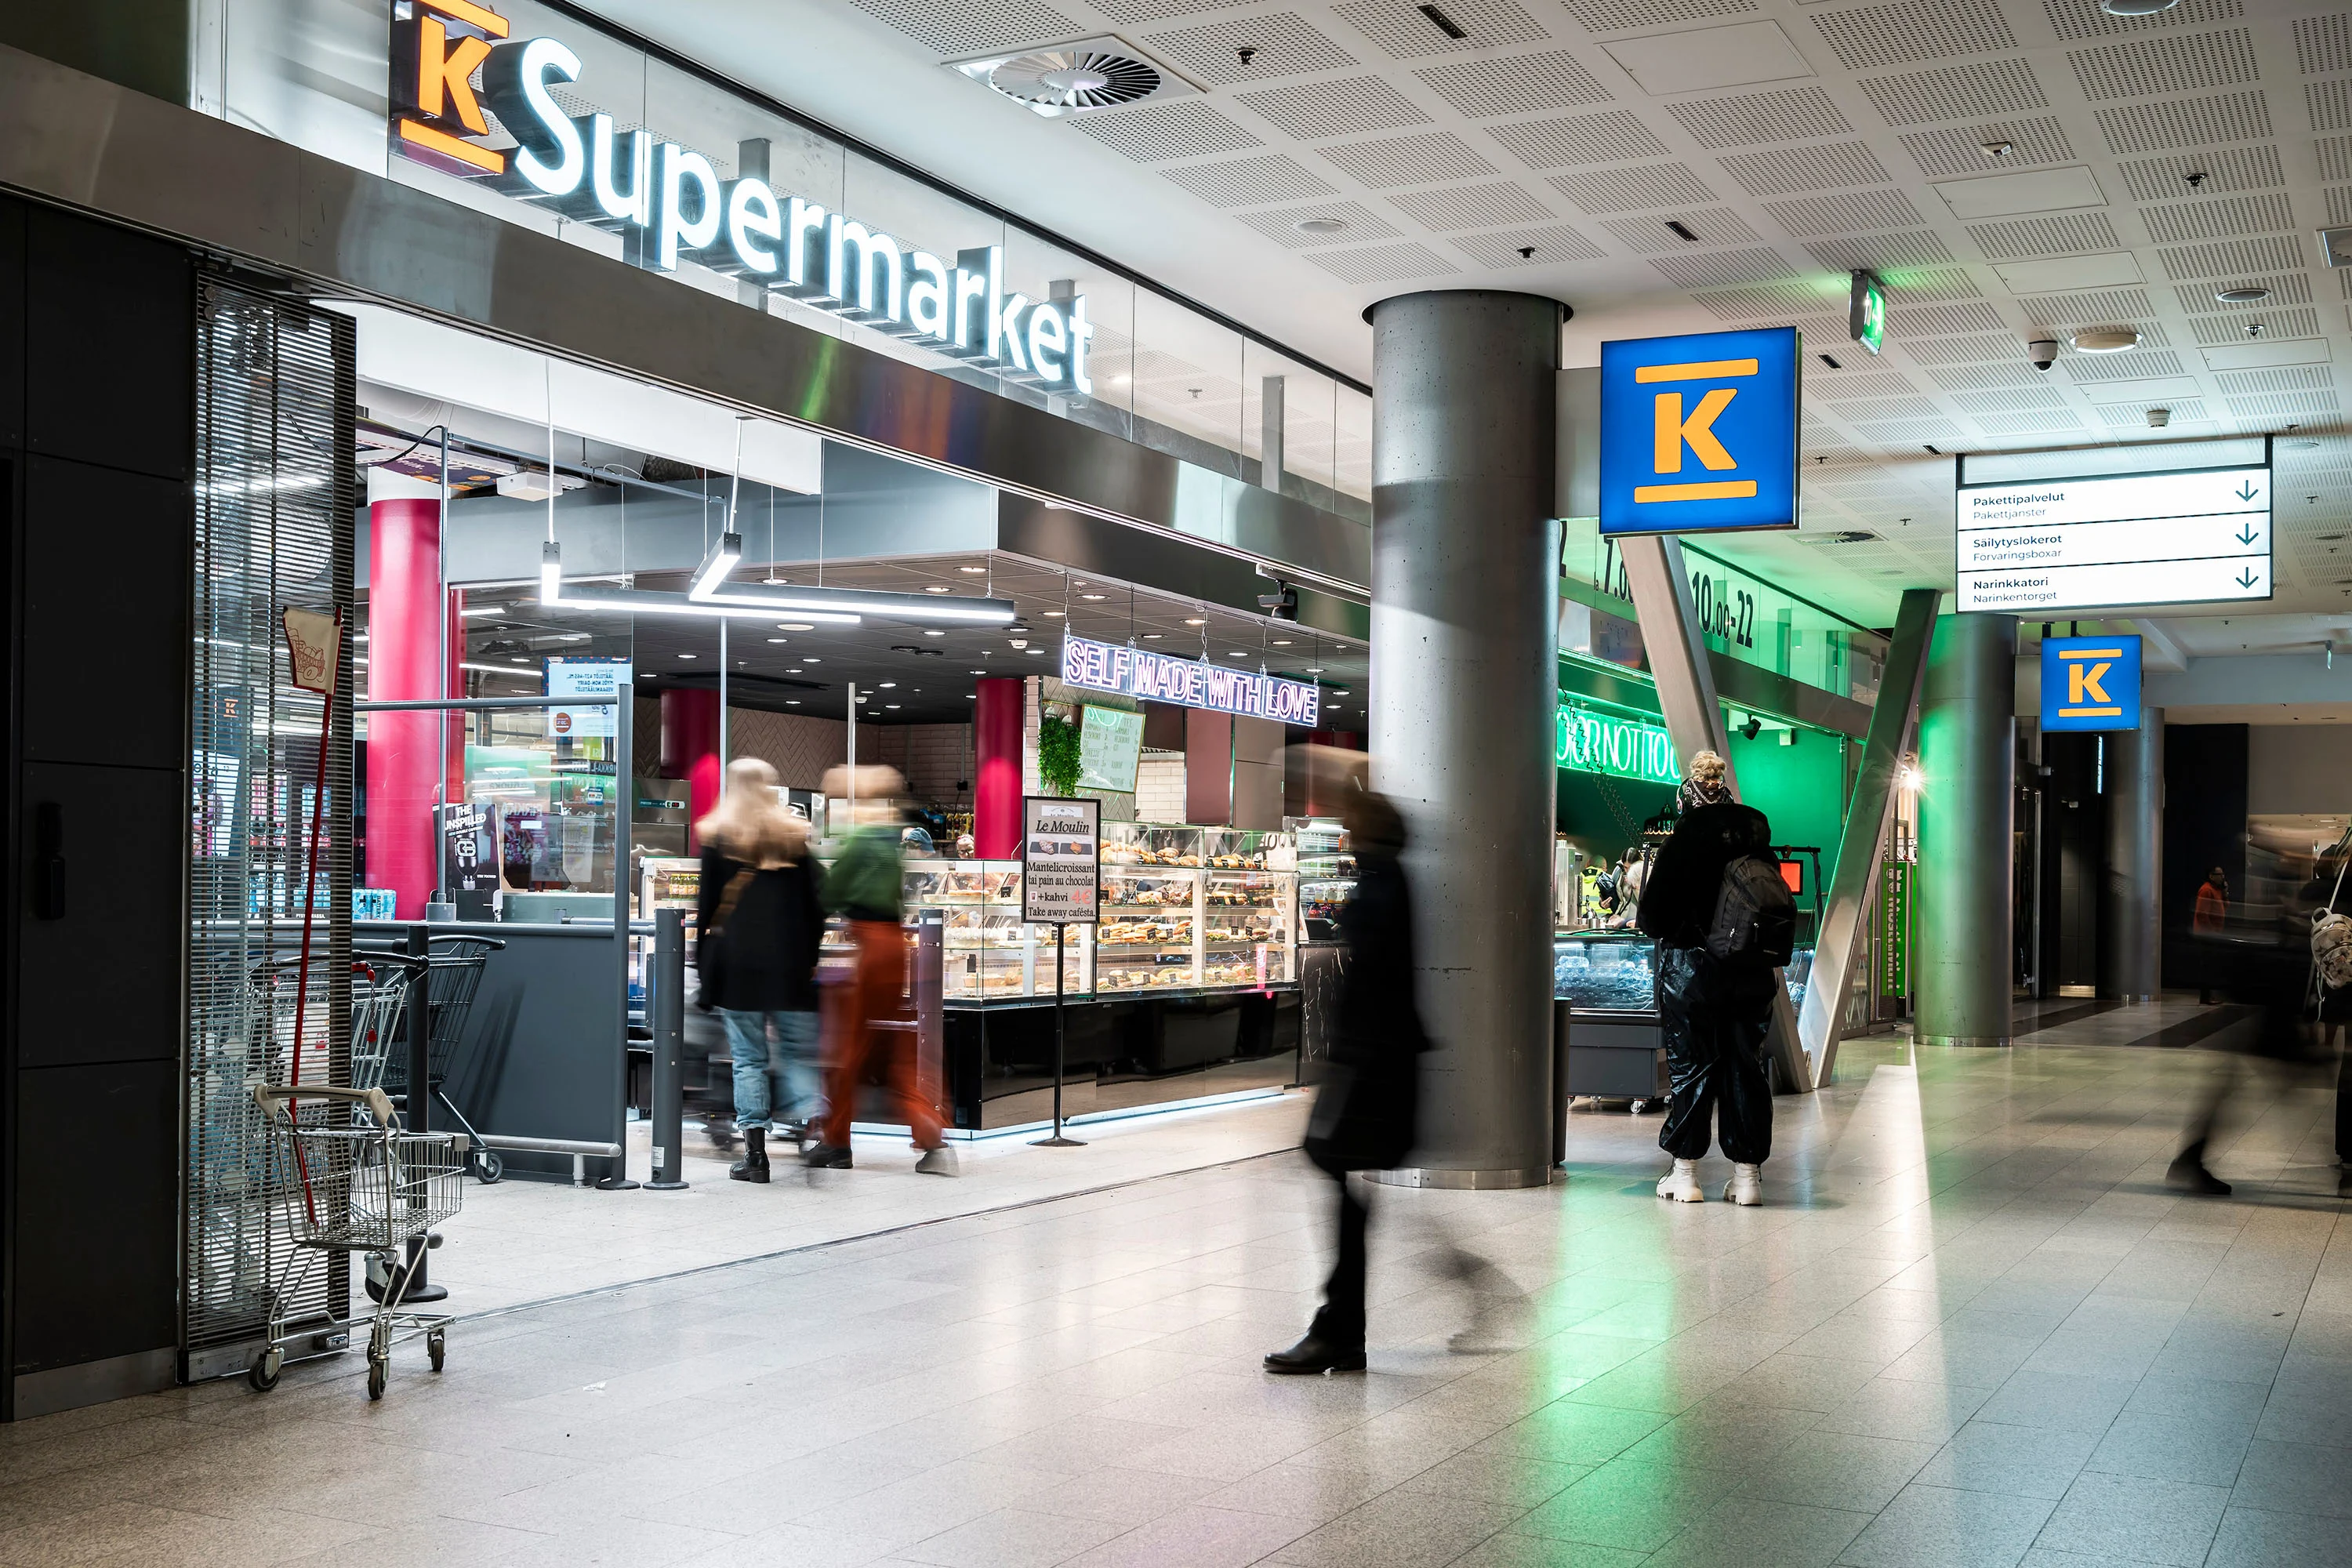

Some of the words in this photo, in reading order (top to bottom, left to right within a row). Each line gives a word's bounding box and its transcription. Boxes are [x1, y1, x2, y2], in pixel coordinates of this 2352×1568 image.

[418, 15, 493, 136] K
[515, 37, 1094, 394] Supermarket
[1653, 387, 1739, 474] K
[1973, 492, 2065, 506] Pakettipalvelut
[1973, 535, 2063, 549] Säilytyslokerot
[1973, 550, 2063, 561] Förvaringsboxar
[1973, 576, 2049, 590] Narinkkatori
[1973, 592, 2057, 603] Narinkentorget
[1066, 641, 1131, 690] SELF
[1134, 655, 1204, 704] MADE
[1206, 667, 1263, 714] WITH
[1265, 680, 1319, 724] LOVE
[2067, 662, 2112, 703] K
[1602, 723, 1642, 772] NOT
[1643, 731, 1668, 777] TO
[456, 806, 470, 816] THE
[1036, 820, 1048, 832] Le
[1051, 820, 1090, 833] Moulin
[1027, 862, 1095, 873] Mantelicroissant
[1028, 875, 1037, 885] tai
[1038, 876, 1054, 887] pain
[1065, 875, 1094, 886] chocolat
[1038, 892, 1068, 902] +kahvi
[1071, 888, 1092, 905] 4€
[1028, 906, 1046, 916] Take
[1047, 909, 1067, 919] away
[1069, 907, 1096, 918] cafésta.
